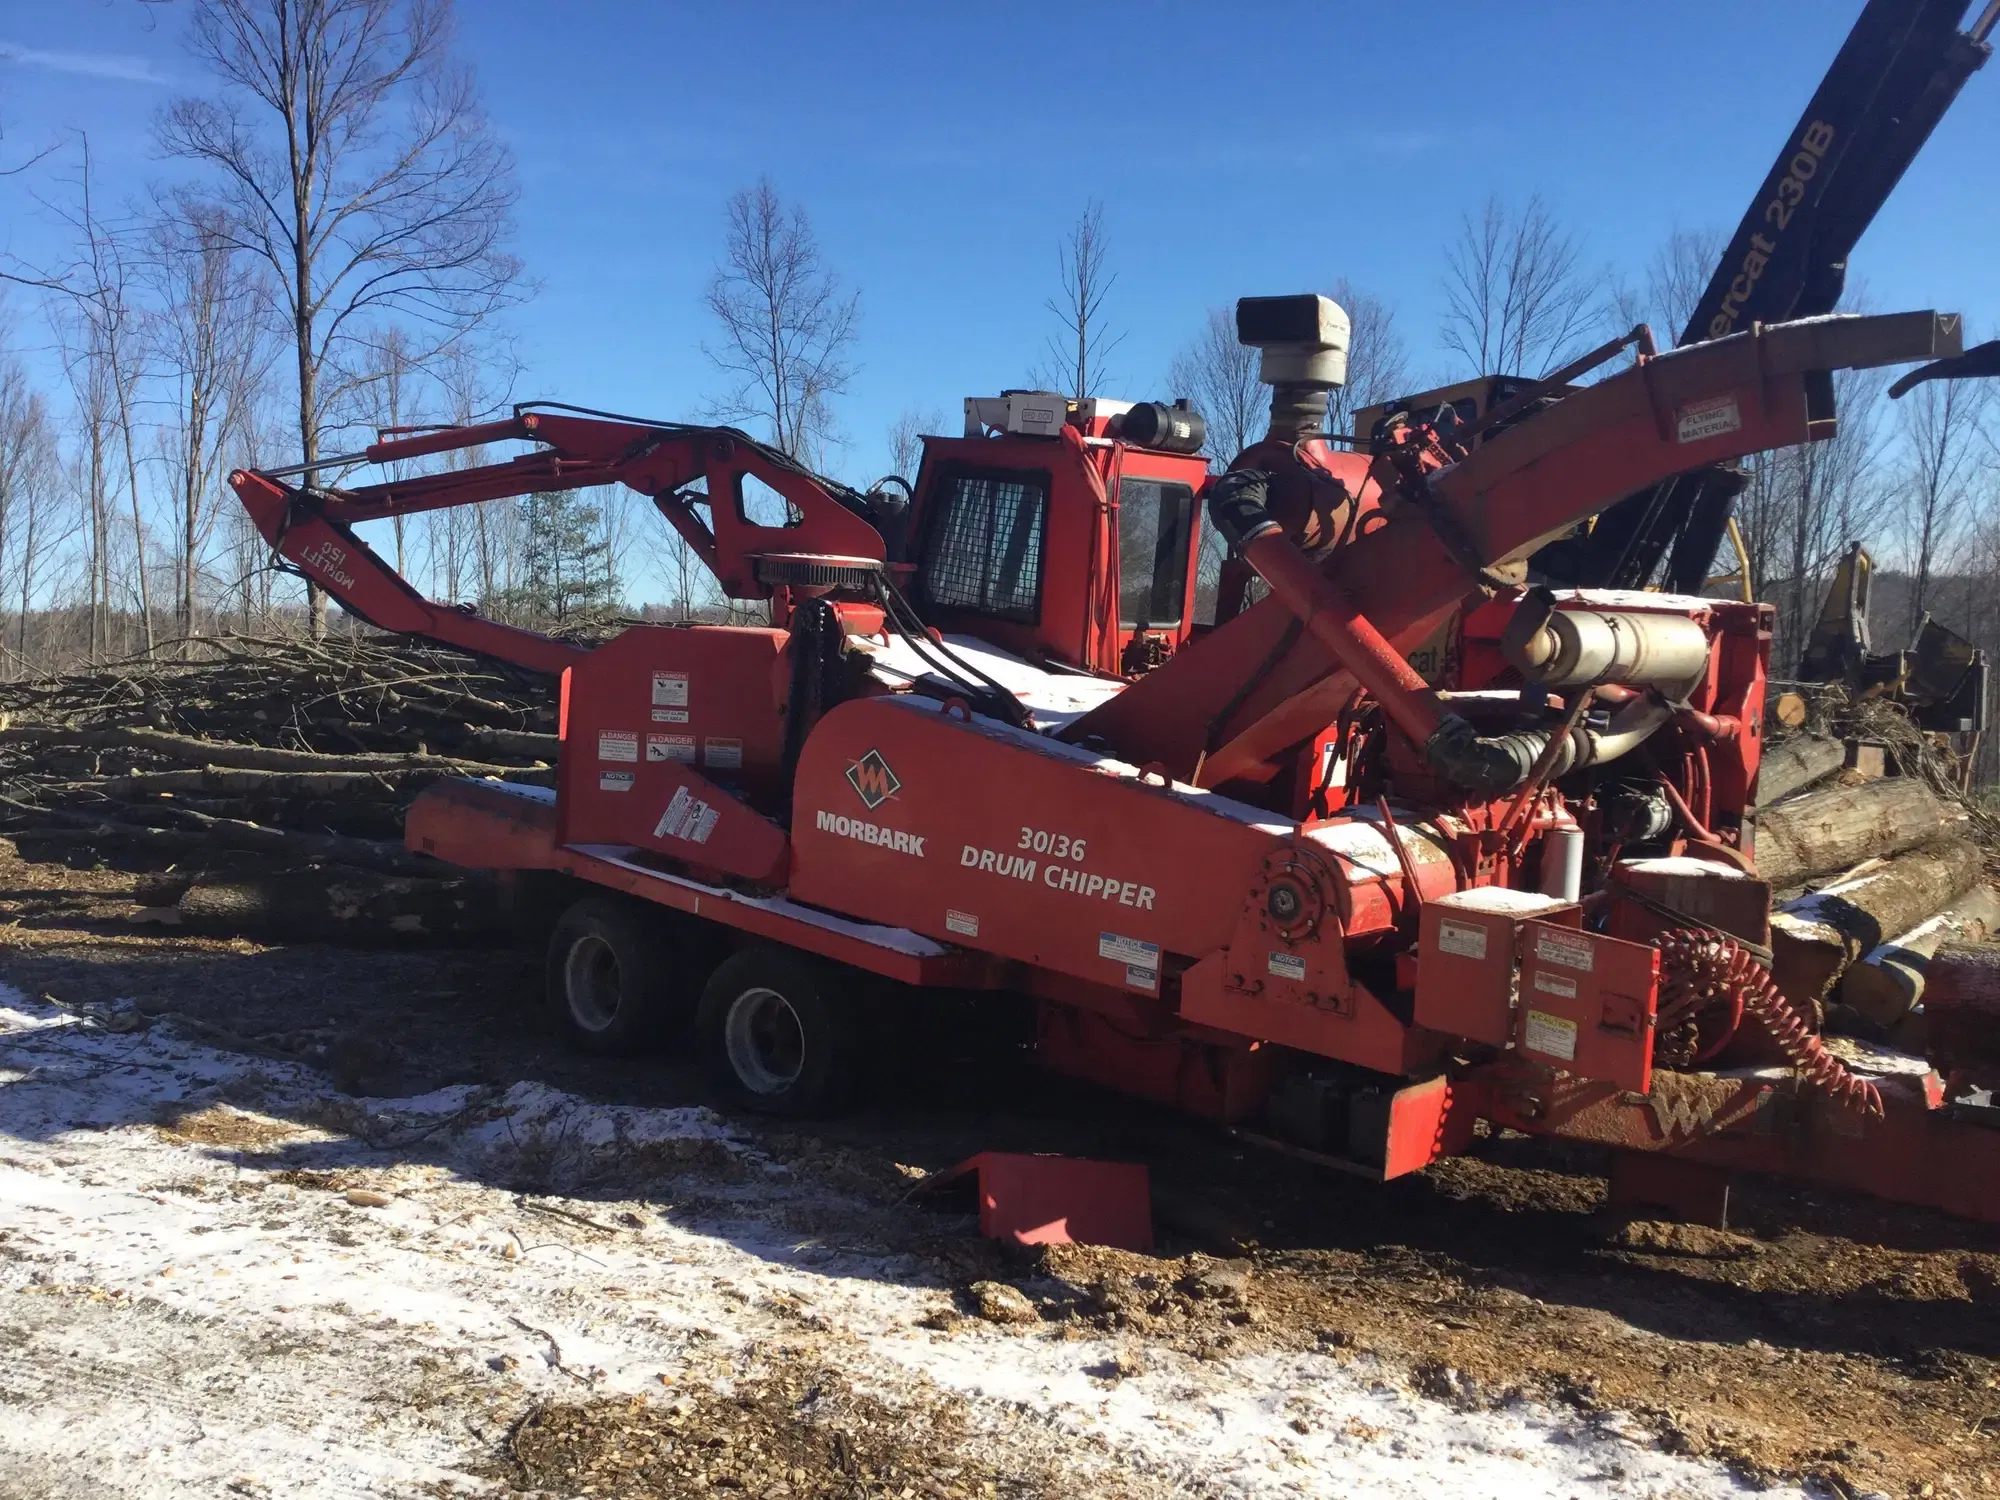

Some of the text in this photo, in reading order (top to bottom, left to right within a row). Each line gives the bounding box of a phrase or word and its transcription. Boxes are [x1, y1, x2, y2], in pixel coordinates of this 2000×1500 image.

[1706, 232, 1776, 340] ercat
[1766, 119, 1835, 231] 230B
[1686, 409, 1725, 425] FLYING
[1681, 421, 1737, 439] MATERIAL
[321, 541, 346, 566] 150
[300, 545, 355, 591] MORLIFT
[660, 672, 687, 681] DANGER
[607, 732, 637, 741] DANGER
[658, 735, 693, 745] DANGER
[605, 772, 630, 780] NOTICE
[816, 810, 926, 858] MORBARK
[1017, 826, 1087, 862] 30/36
[960, 845, 1156, 910] DRUM CHIPPER
[953, 912, 977, 924] DANGER
[1115, 936, 1143, 948] NOTICE
[1551, 933, 1590, 950] DANGER
[1275, 954, 1301, 966] NOTICE
[1132, 969, 1151, 979] NOTICE
[1536, 1013, 1572, 1029] CAUTION
